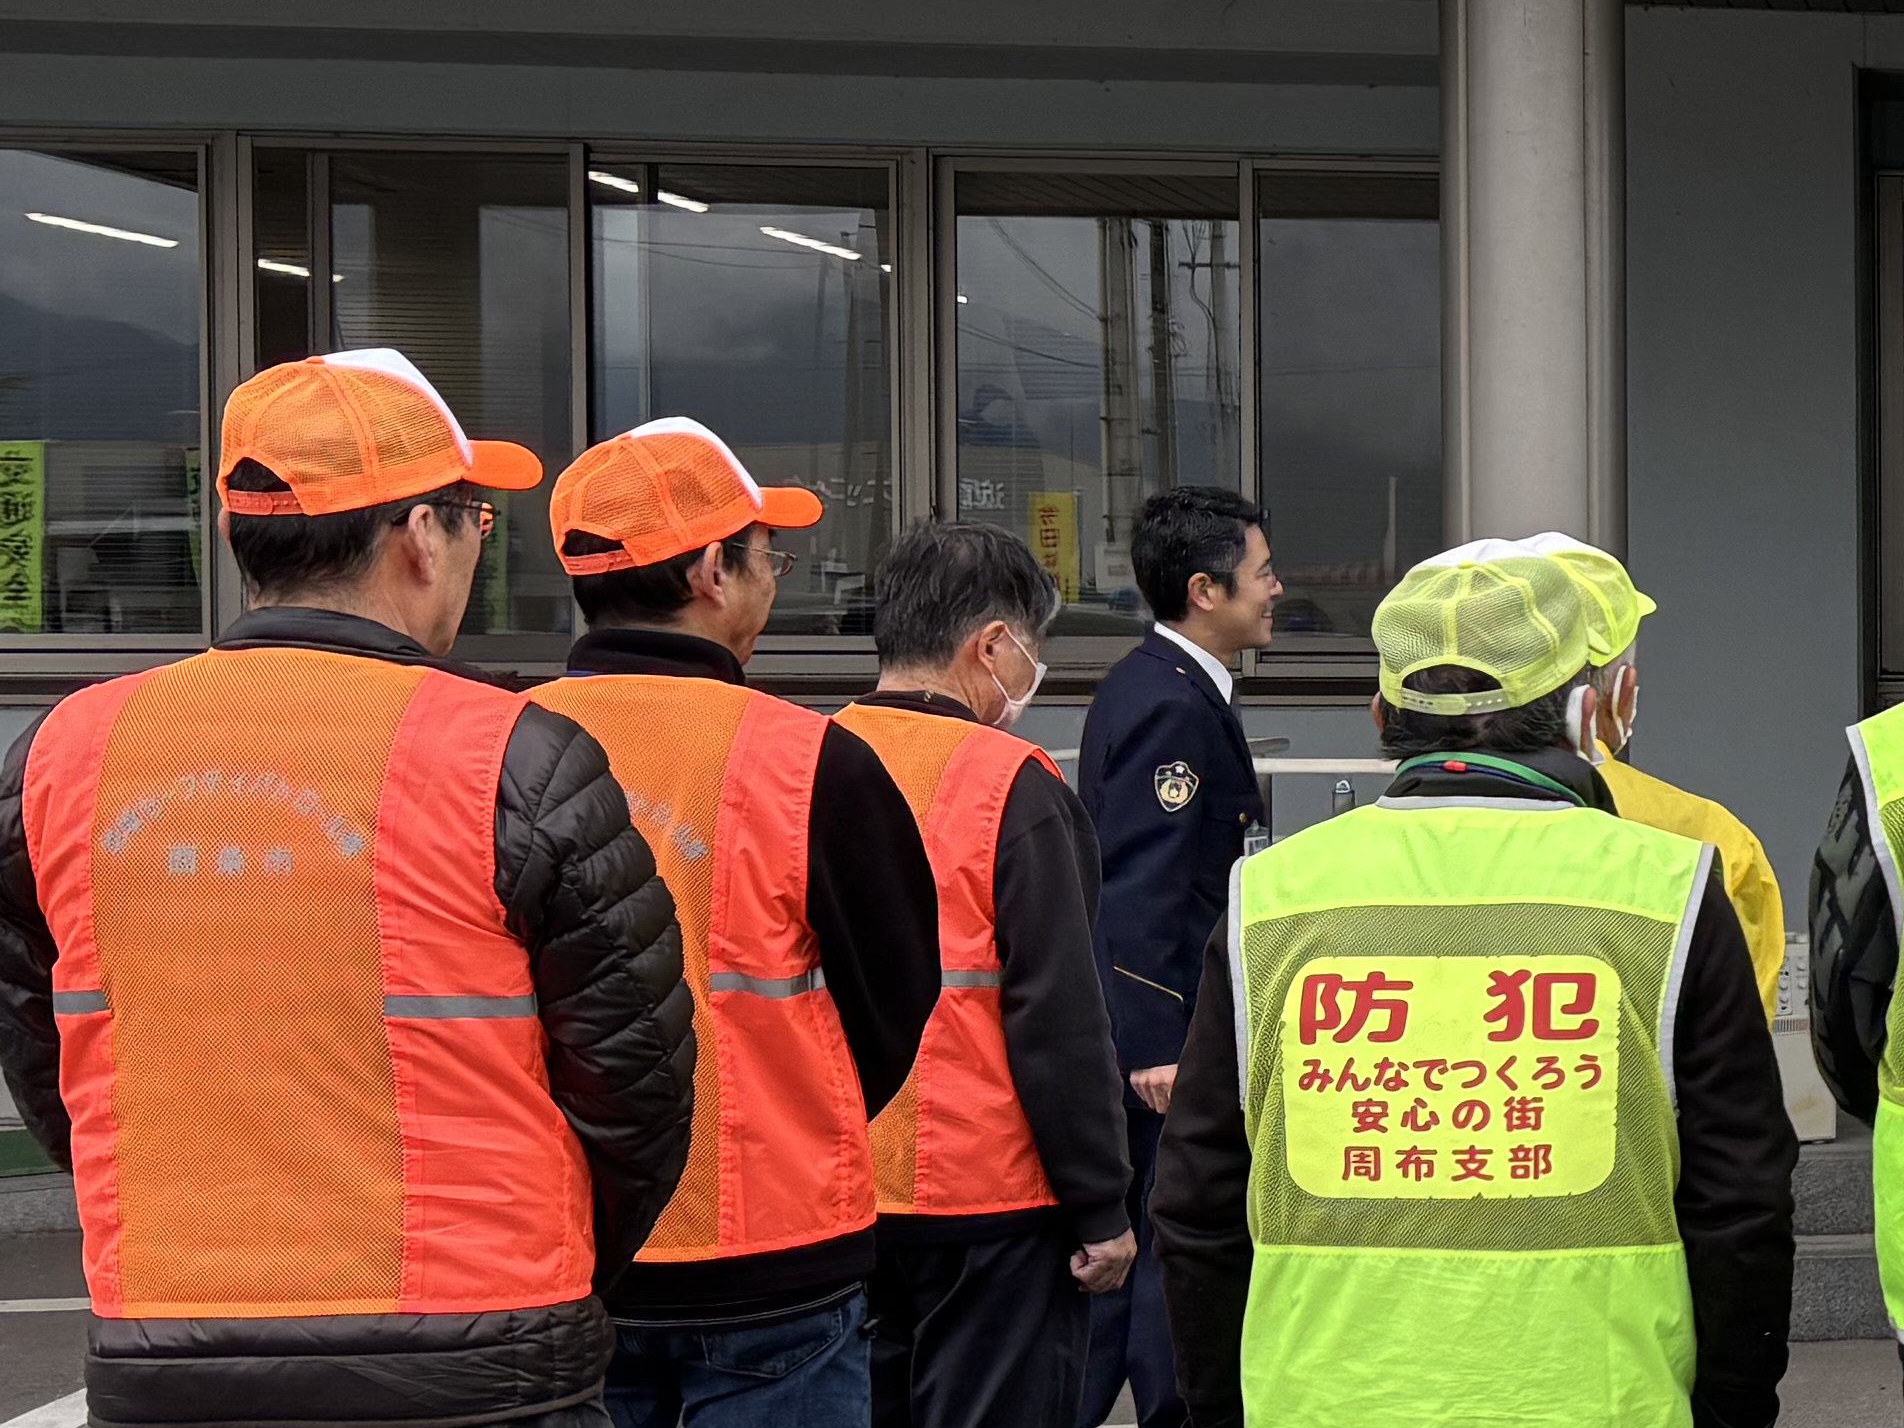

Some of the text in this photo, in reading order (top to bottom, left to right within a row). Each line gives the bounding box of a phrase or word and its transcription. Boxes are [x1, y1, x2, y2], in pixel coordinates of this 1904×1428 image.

[1299, 969, 1600, 1045] 防犯
[1298, 1055, 1602, 1092] みんなでつくろう
[1351, 1097, 1545, 1133] 安心の街
[1342, 1144, 1553, 1181] 周布支部
